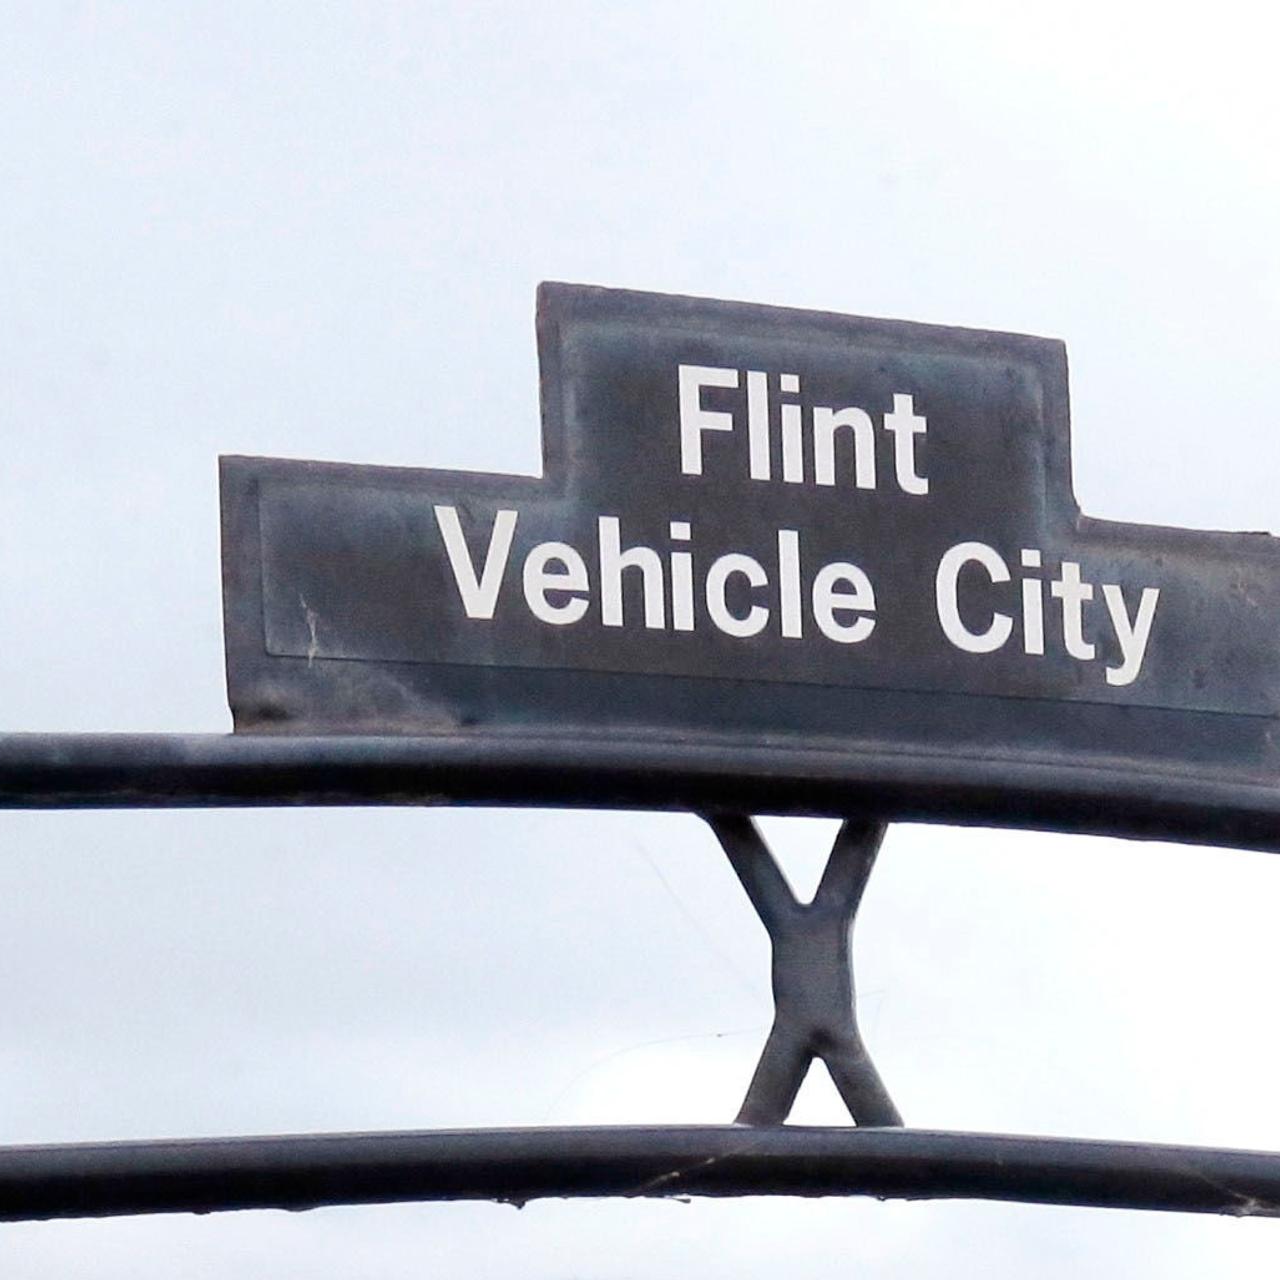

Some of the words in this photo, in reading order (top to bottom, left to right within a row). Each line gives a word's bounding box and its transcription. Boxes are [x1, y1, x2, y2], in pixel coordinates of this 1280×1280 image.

[679, 365, 928, 495] Flint
[434, 505, 875, 643] Vehicle
[936, 542, 1160, 686] City
